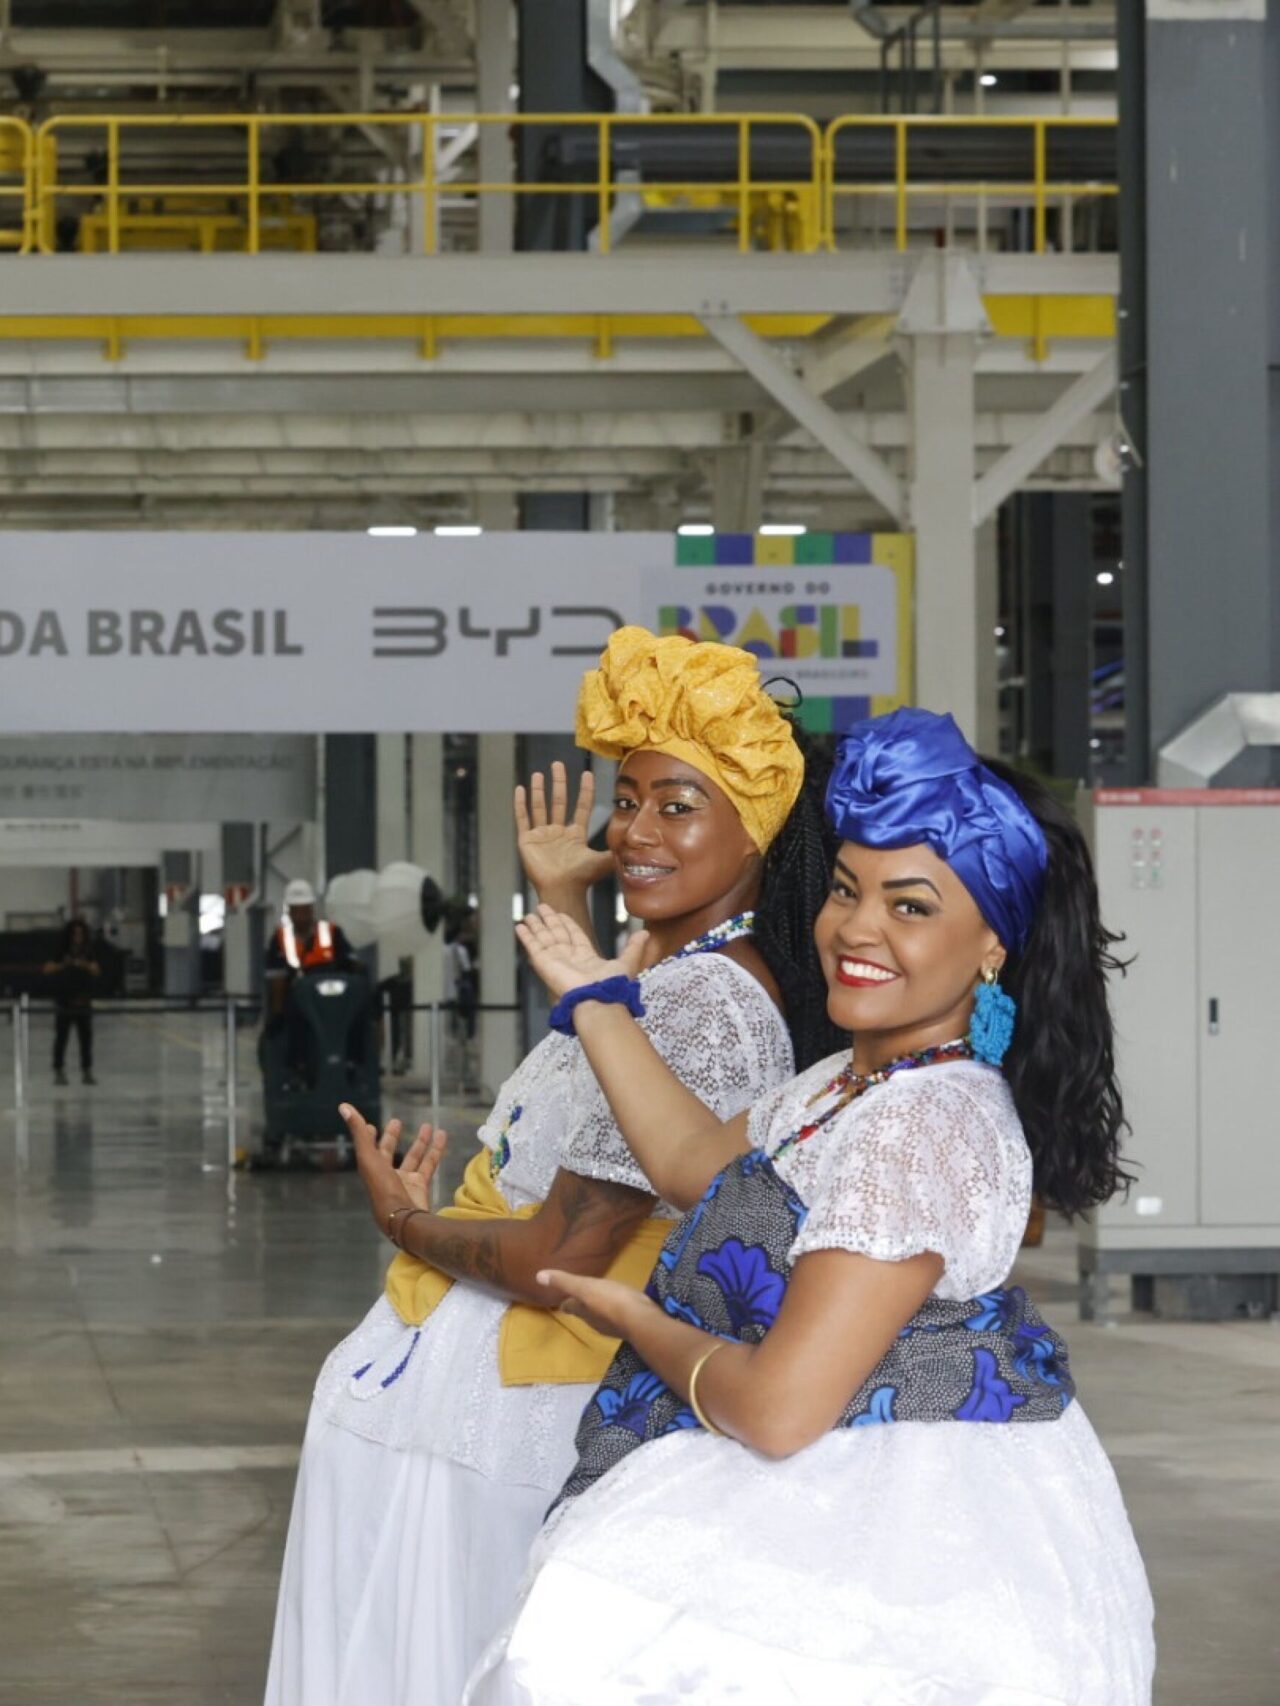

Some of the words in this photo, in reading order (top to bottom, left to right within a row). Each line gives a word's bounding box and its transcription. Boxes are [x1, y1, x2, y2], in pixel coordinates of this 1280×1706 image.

[706, 582, 796, 596] GOVERNO
[804, 582, 832, 596] DO
[85, 608, 305, 658] BRASIL
[372, 605, 626, 658] BYD
